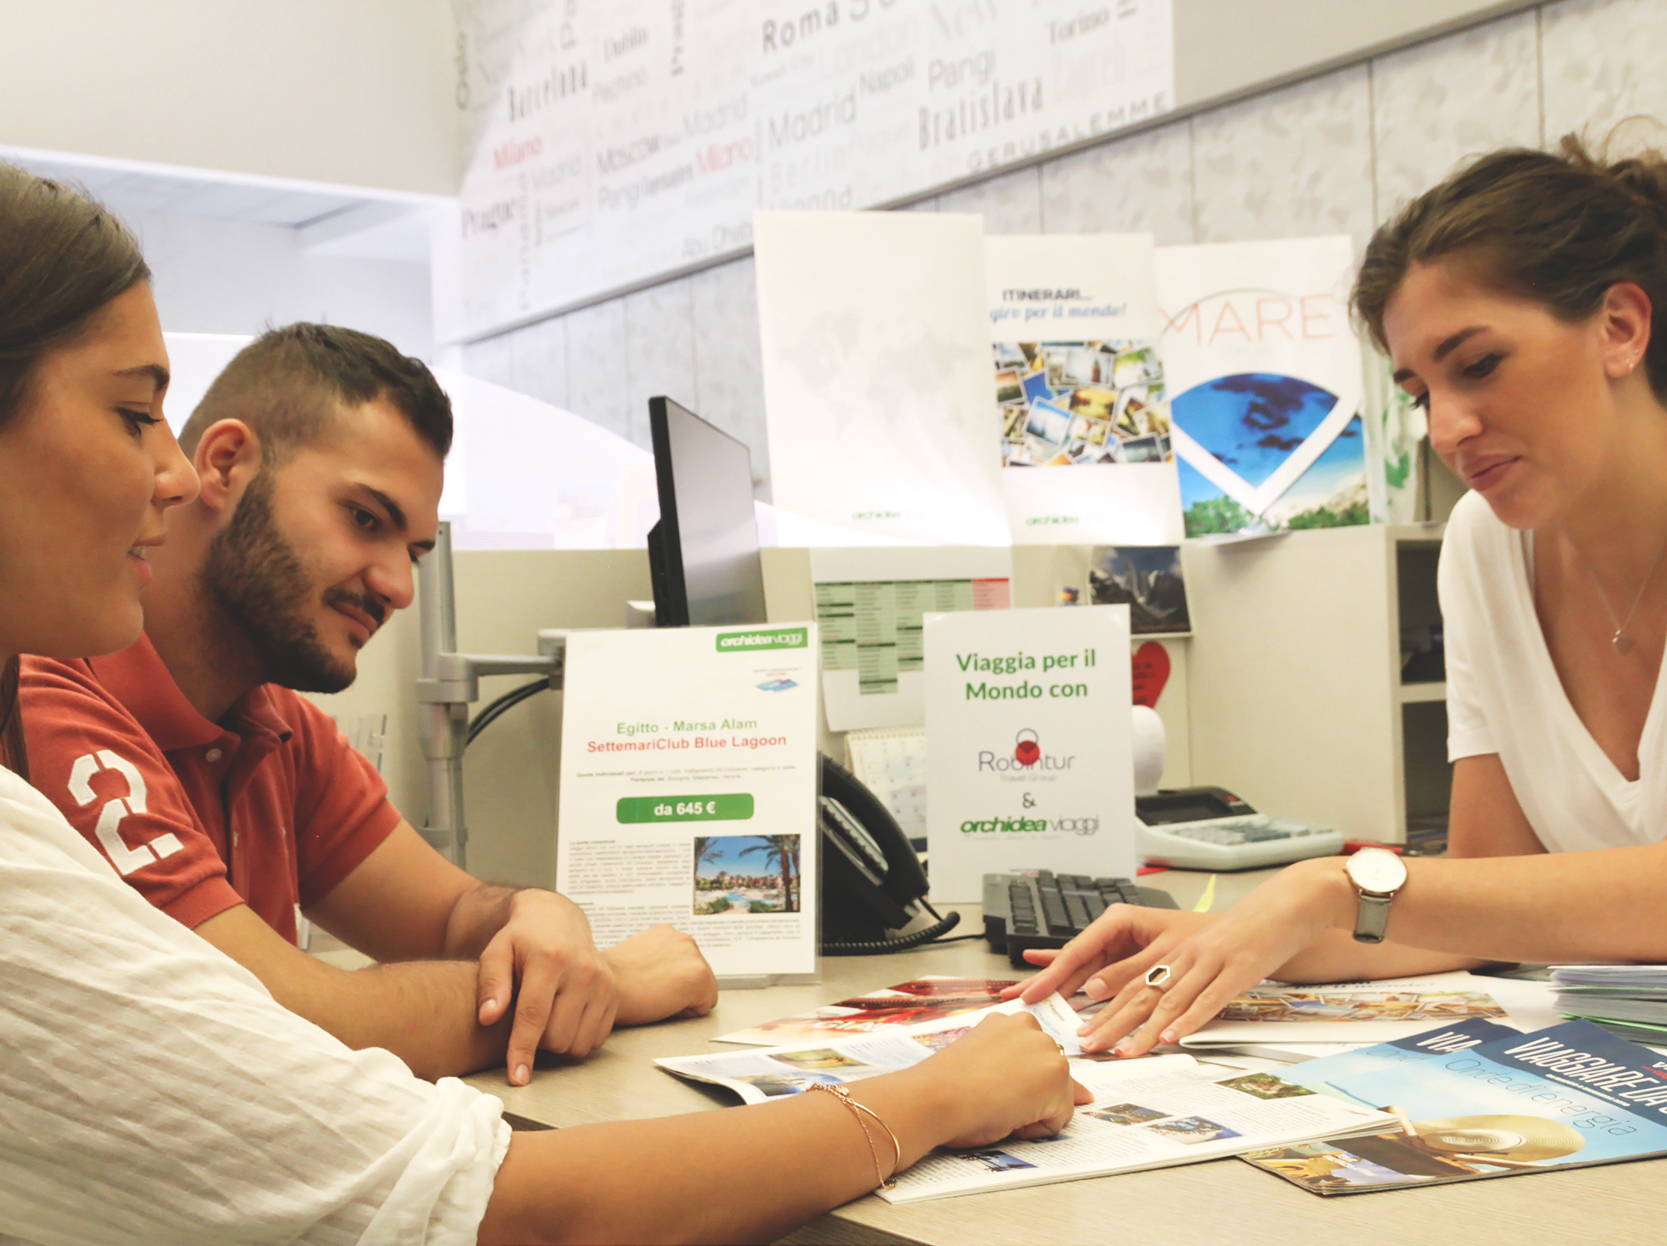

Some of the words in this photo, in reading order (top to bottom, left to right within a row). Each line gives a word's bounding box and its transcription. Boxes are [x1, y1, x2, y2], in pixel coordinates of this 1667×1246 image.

[762, 1, 839, 56] Roma
[859, 54, 915, 98] Napoli
[768, 87, 857, 150] Madrid
[917, 75, 1044, 151] Bratislava
[967, 91, 1168, 173] GERUSALEMME
[492, 135, 543, 171] Milano
[696, 135, 753, 175] Milano
[1024, 305, 1048, 323] per
[1053, 303, 1064, 318] il
[1158, 293, 1336, 346] MARE
[720, 634, 773, 648] orchidea
[956, 651, 1036, 675] Viaggia
[1043, 654, 1078, 673] per
[1084, 648, 1096, 667] il
[966, 680, 1043, 700] Mondo
[1050, 683, 1089, 698] con
[587, 738, 690, 753] SettemariClub
[694, 737, 727, 748] Blue
[732, 736, 787, 749] Lagoon
[617, 722, 659, 736] Egitto
[673, 720, 716, 731] Marsa
[720, 719, 758, 730] Alam
[978, 750, 1076, 772] Robintur
[68, 749, 185, 876] 2
[654, 803, 673, 816] da
[676, 802, 703, 815] 645
[706, 801, 716, 814] €
[1022, 792, 1036, 808] &
[960, 816, 1047, 833] orchidea
[1049, 814, 1099, 836] viaggi
[1504, 1036, 1660, 1092] VIAGGIARE
[1445, 1059, 1513, 1085] Onde
[1531, 1093, 1637, 1136] energia
